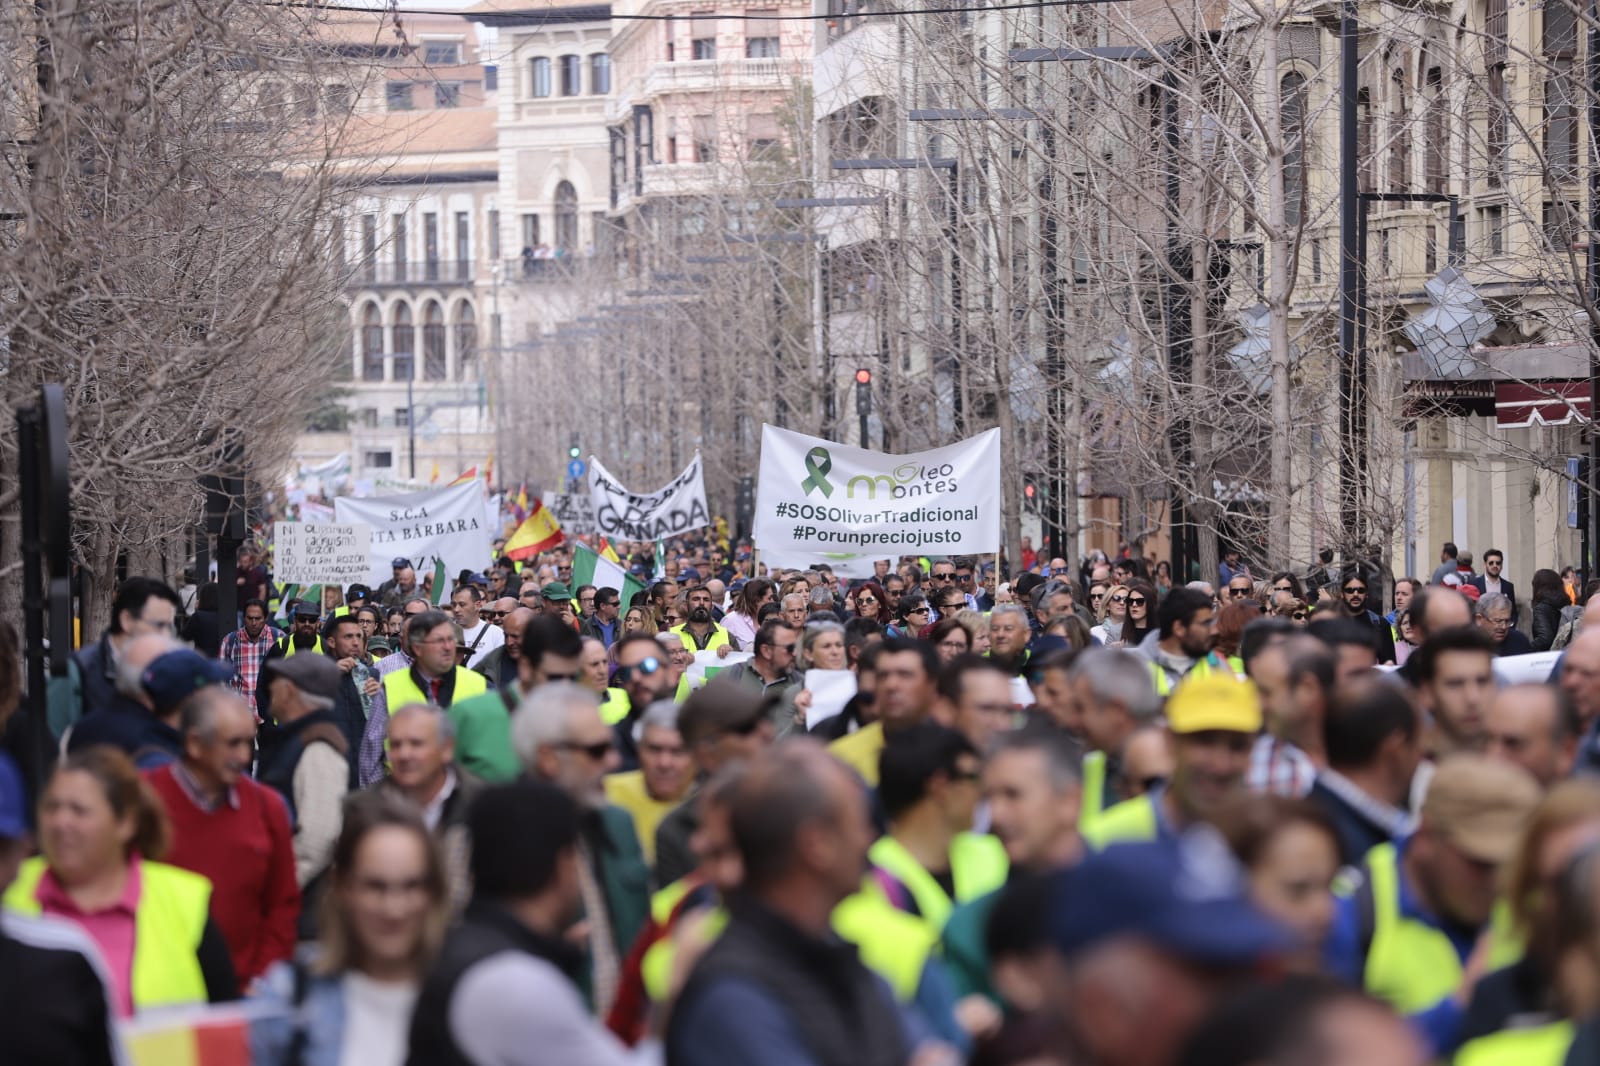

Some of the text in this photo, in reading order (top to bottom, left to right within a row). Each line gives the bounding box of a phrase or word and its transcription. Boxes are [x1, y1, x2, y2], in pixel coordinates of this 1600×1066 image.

[598, 498, 709, 540] GRANADA
[776, 501, 978, 525] #SOSOlivarTradicional
[402, 517, 480, 541] BÁRBARA
[793, 525, 963, 547] #Porunpreciojusto
